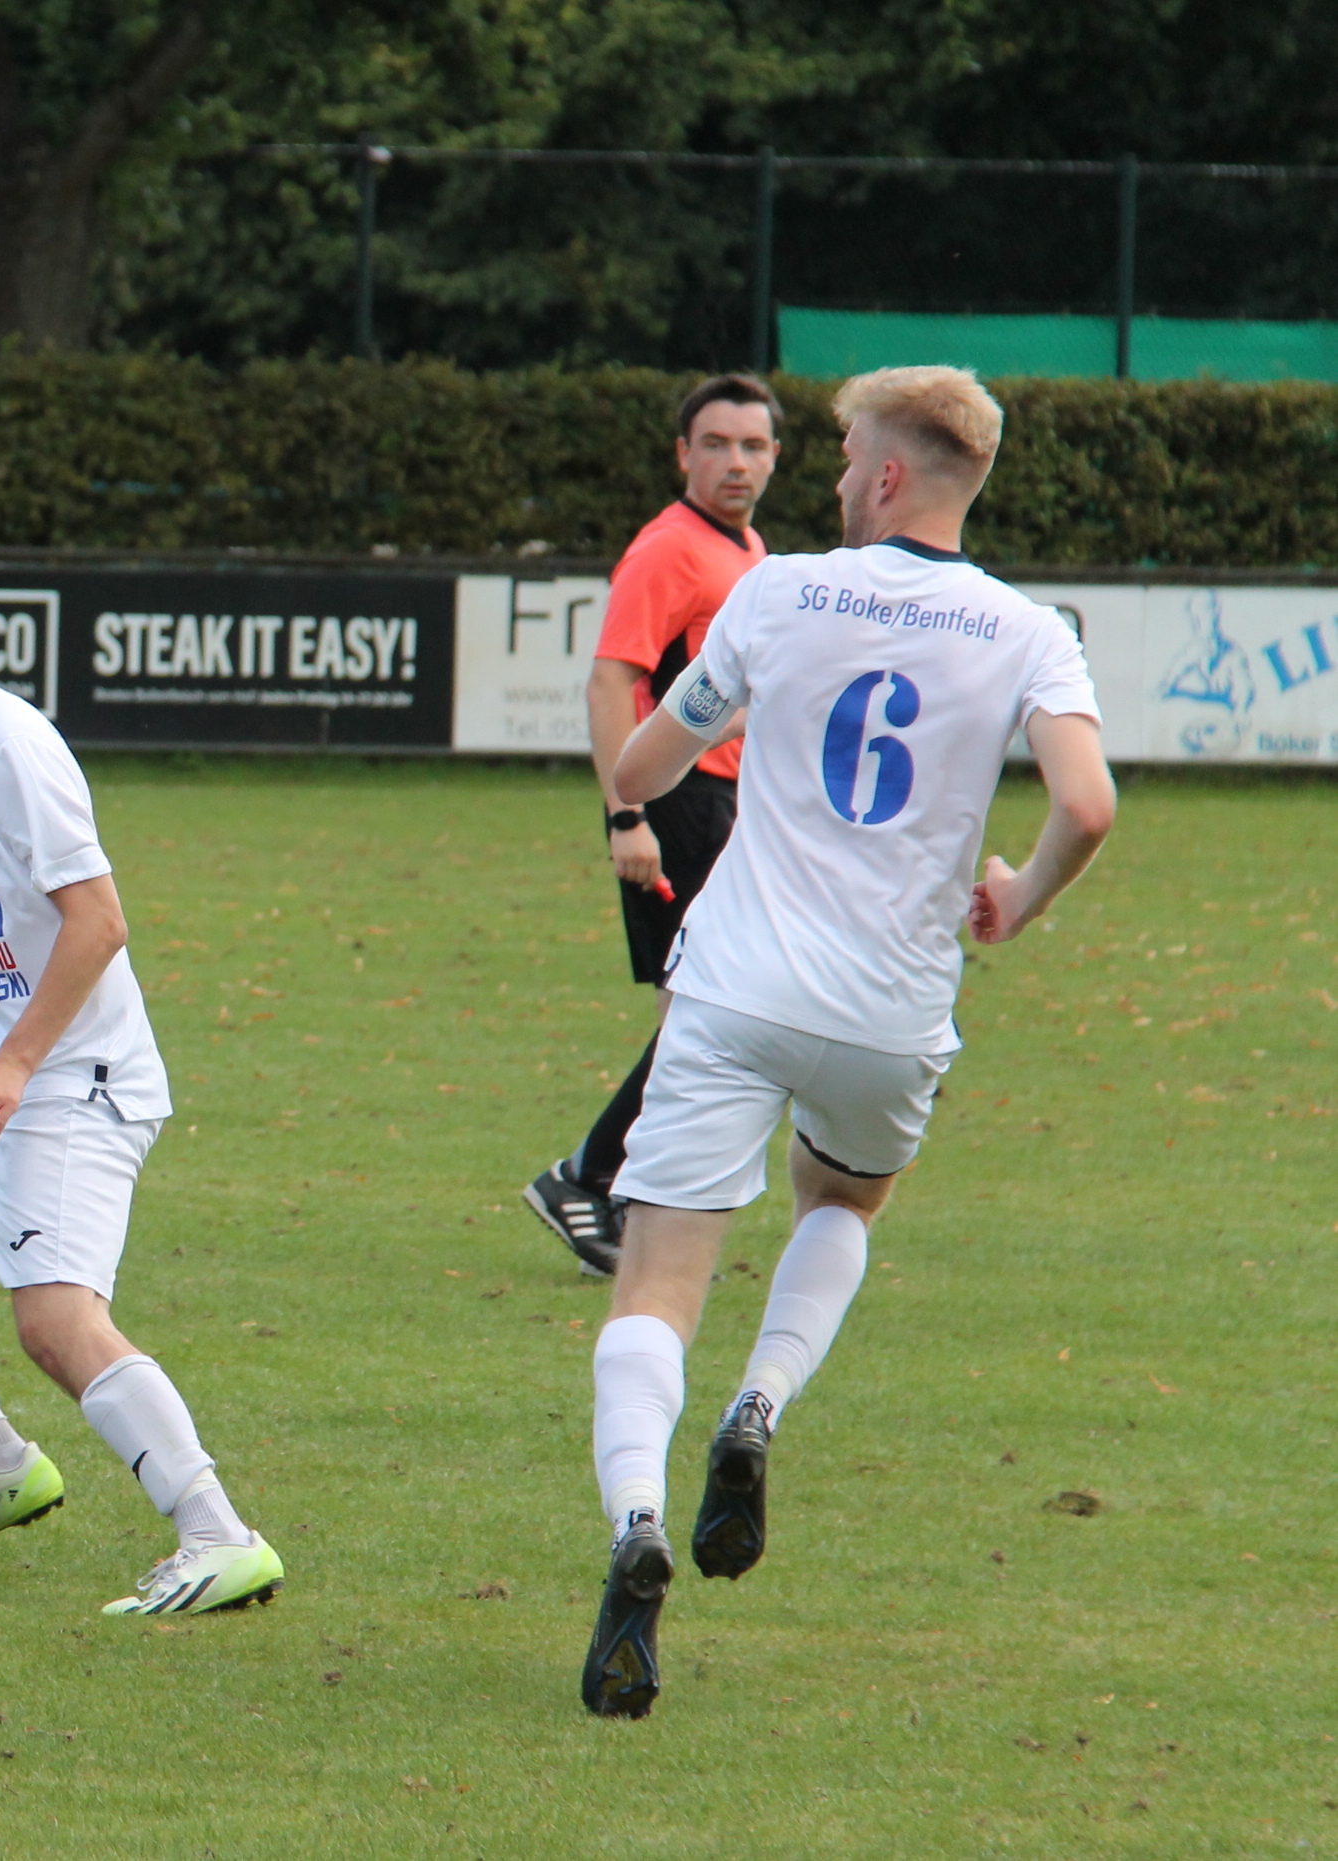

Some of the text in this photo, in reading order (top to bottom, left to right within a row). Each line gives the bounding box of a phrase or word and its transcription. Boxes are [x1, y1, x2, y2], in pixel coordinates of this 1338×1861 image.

[797, 583, 1000, 640] SG Boke/Bentfeld
[93, 612, 418, 681] STEAK IT EASY!
[1262, 613, 1338, 693] LI
[687, 692, 719, 718] BOKE
[822, 669, 922, 826] 6
